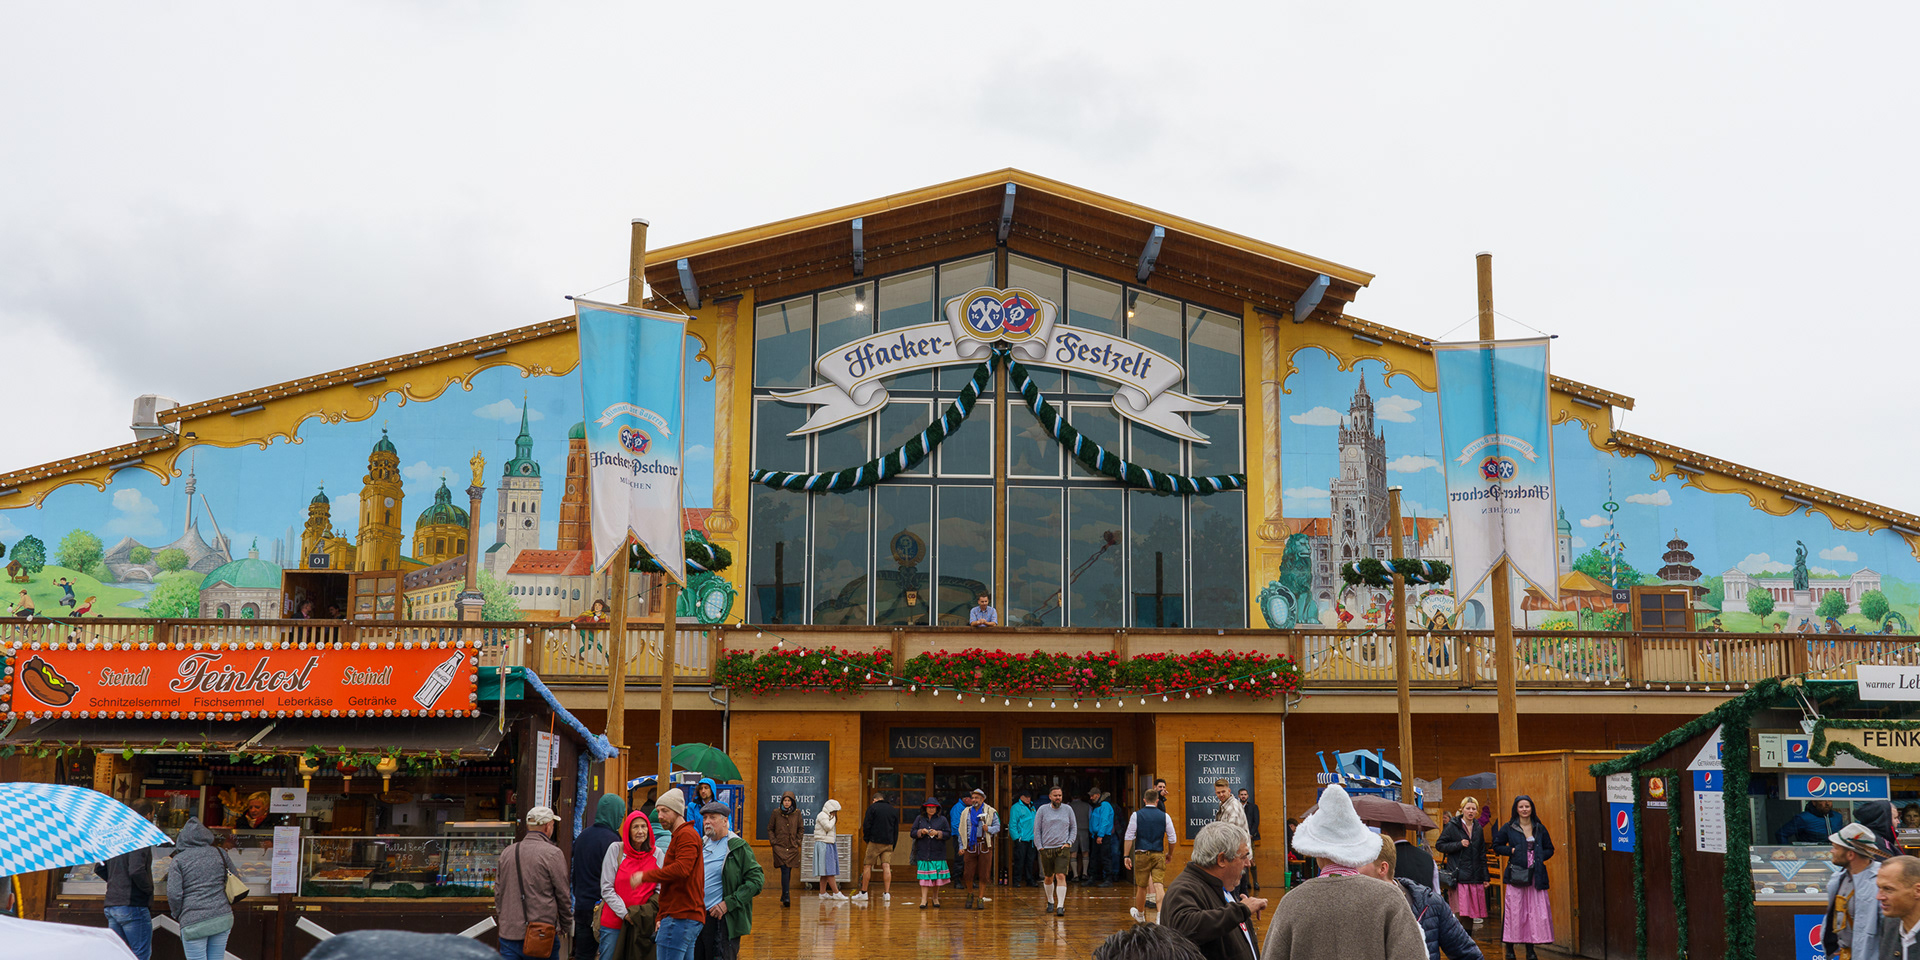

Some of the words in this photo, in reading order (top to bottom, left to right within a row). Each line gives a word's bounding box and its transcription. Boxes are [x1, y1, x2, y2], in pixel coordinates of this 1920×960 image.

[844, 333, 952, 378] Hacker-
[1055, 332, 1152, 380] Festzelt
[619, 476, 652, 490] MCHEN
[1615, 592, 1627, 600] 05
[98, 666, 151, 687] Steindl
[169, 653, 320, 693] Feinkost
[341, 665, 393, 686] Steindl
[1865, 681, 1895, 689] warmer
[89, 697, 181, 708] Schnitzelsemmel
[194, 697, 265, 707] Fischsemmel
[278, 696, 333, 707] Leberkäse
[348, 696, 397, 707] Getränke
[896, 736, 975, 749] AUSGANG
[1030, 736, 1105, 749] EINGANG
[771, 752, 816, 761] FESTWIRT
[1198, 754, 1241, 762] FESTWIRT
[1766, 751, 1775, 760] 71
[776, 766, 811, 774] FAMILIE
[1202, 767, 1236, 775] FAMILIE
[771, 775, 816, 784] ROIDERER
[1829, 780, 1870, 795] pepsi
[771, 795, 816, 803] FEWIRT
